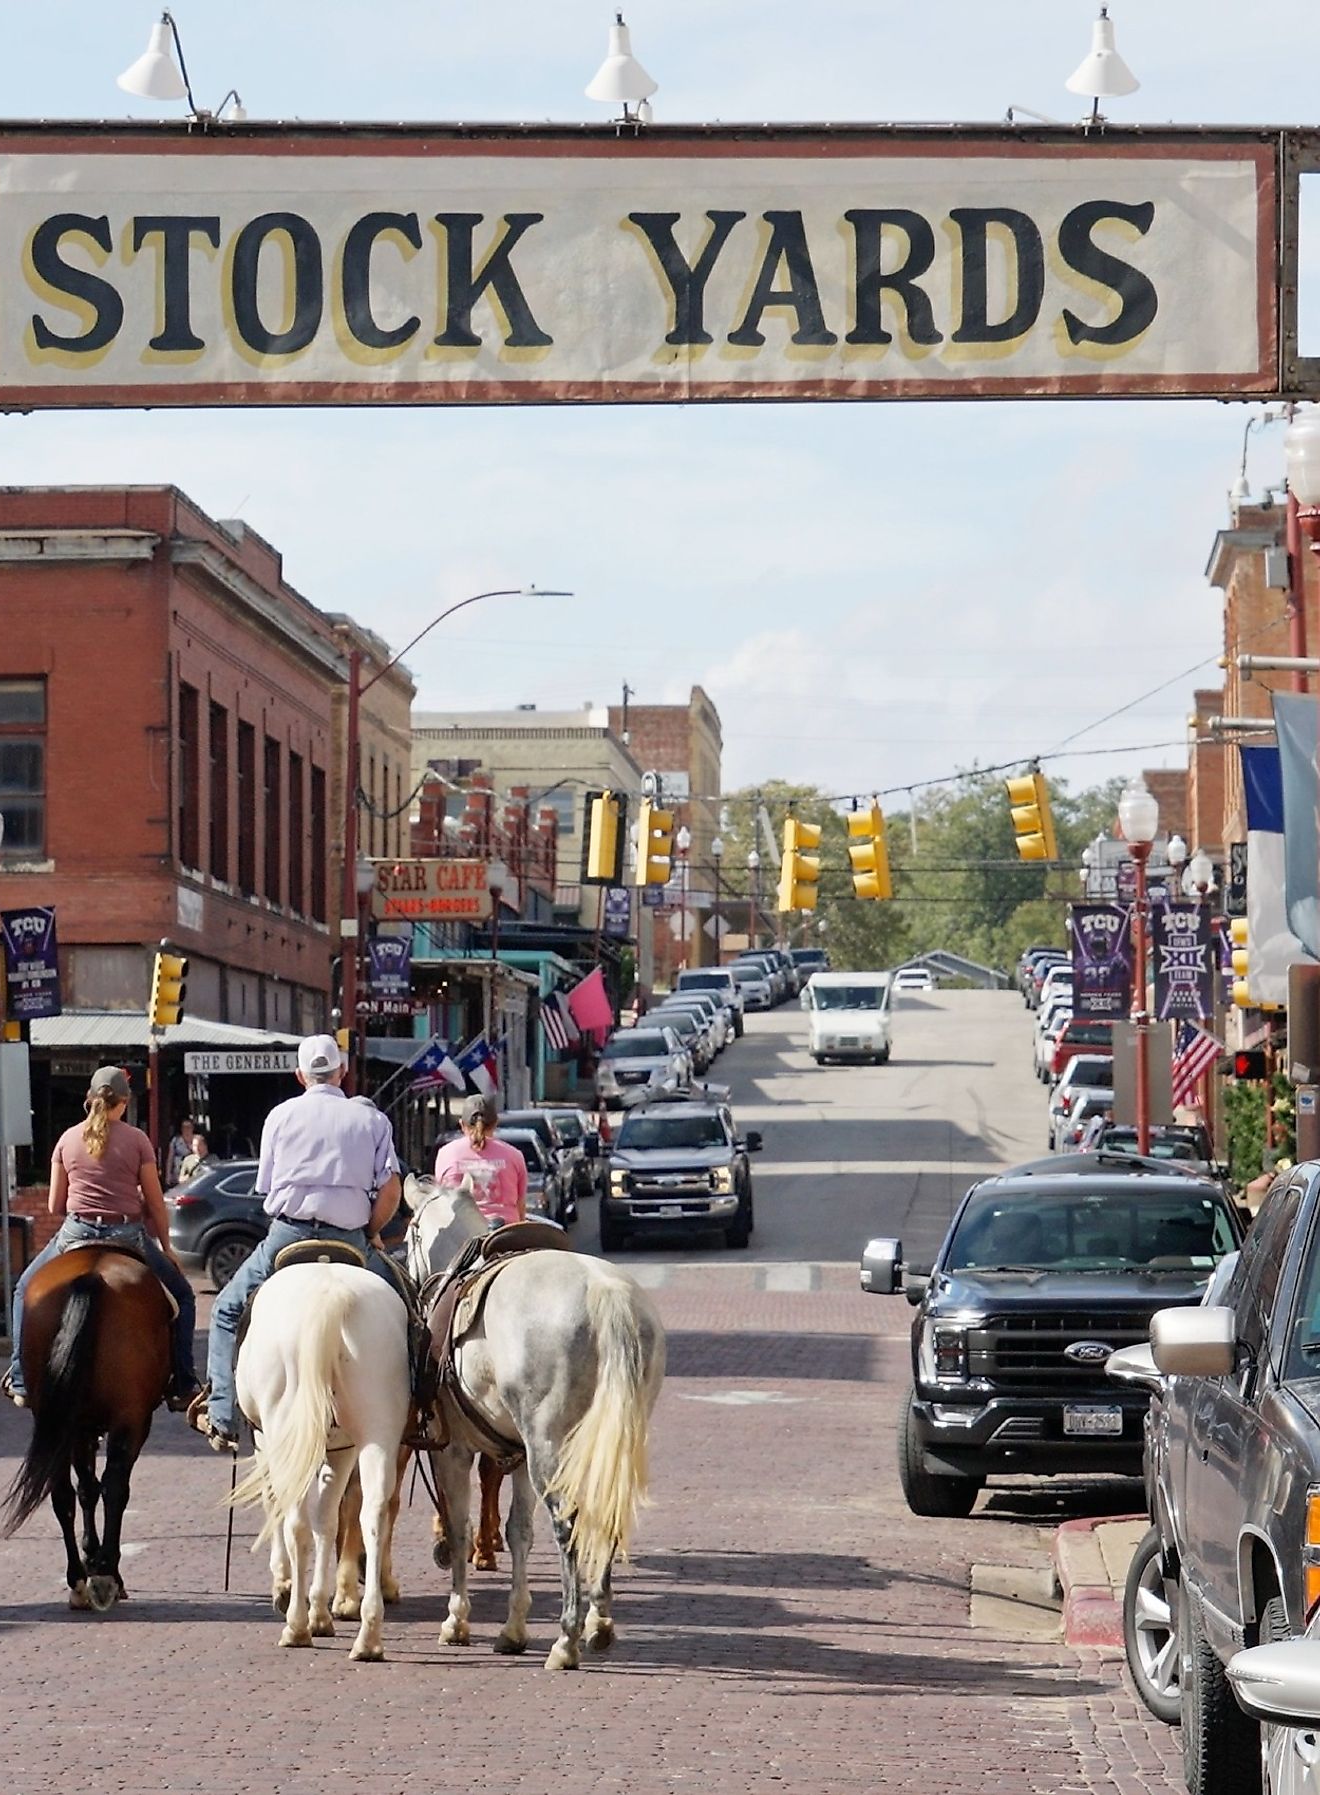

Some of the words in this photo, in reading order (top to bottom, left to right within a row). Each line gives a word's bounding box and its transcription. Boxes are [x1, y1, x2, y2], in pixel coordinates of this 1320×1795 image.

[30, 211, 553, 352] STOCK
[628, 200, 1159, 348] YARDS
[377, 865, 427, 891] STAR
[436, 863, 488, 891] CAFE
[10, 915, 46, 937] TCU
[1081, 913, 1120, 933] TCU
[1161, 911, 1201, 932] TCU
[376, 942, 403, 956] TCU
[383, 1001, 409, 1013] Main
[191, 1055, 220, 1070] THE
[225, 1054, 291, 1070] GENERAL
